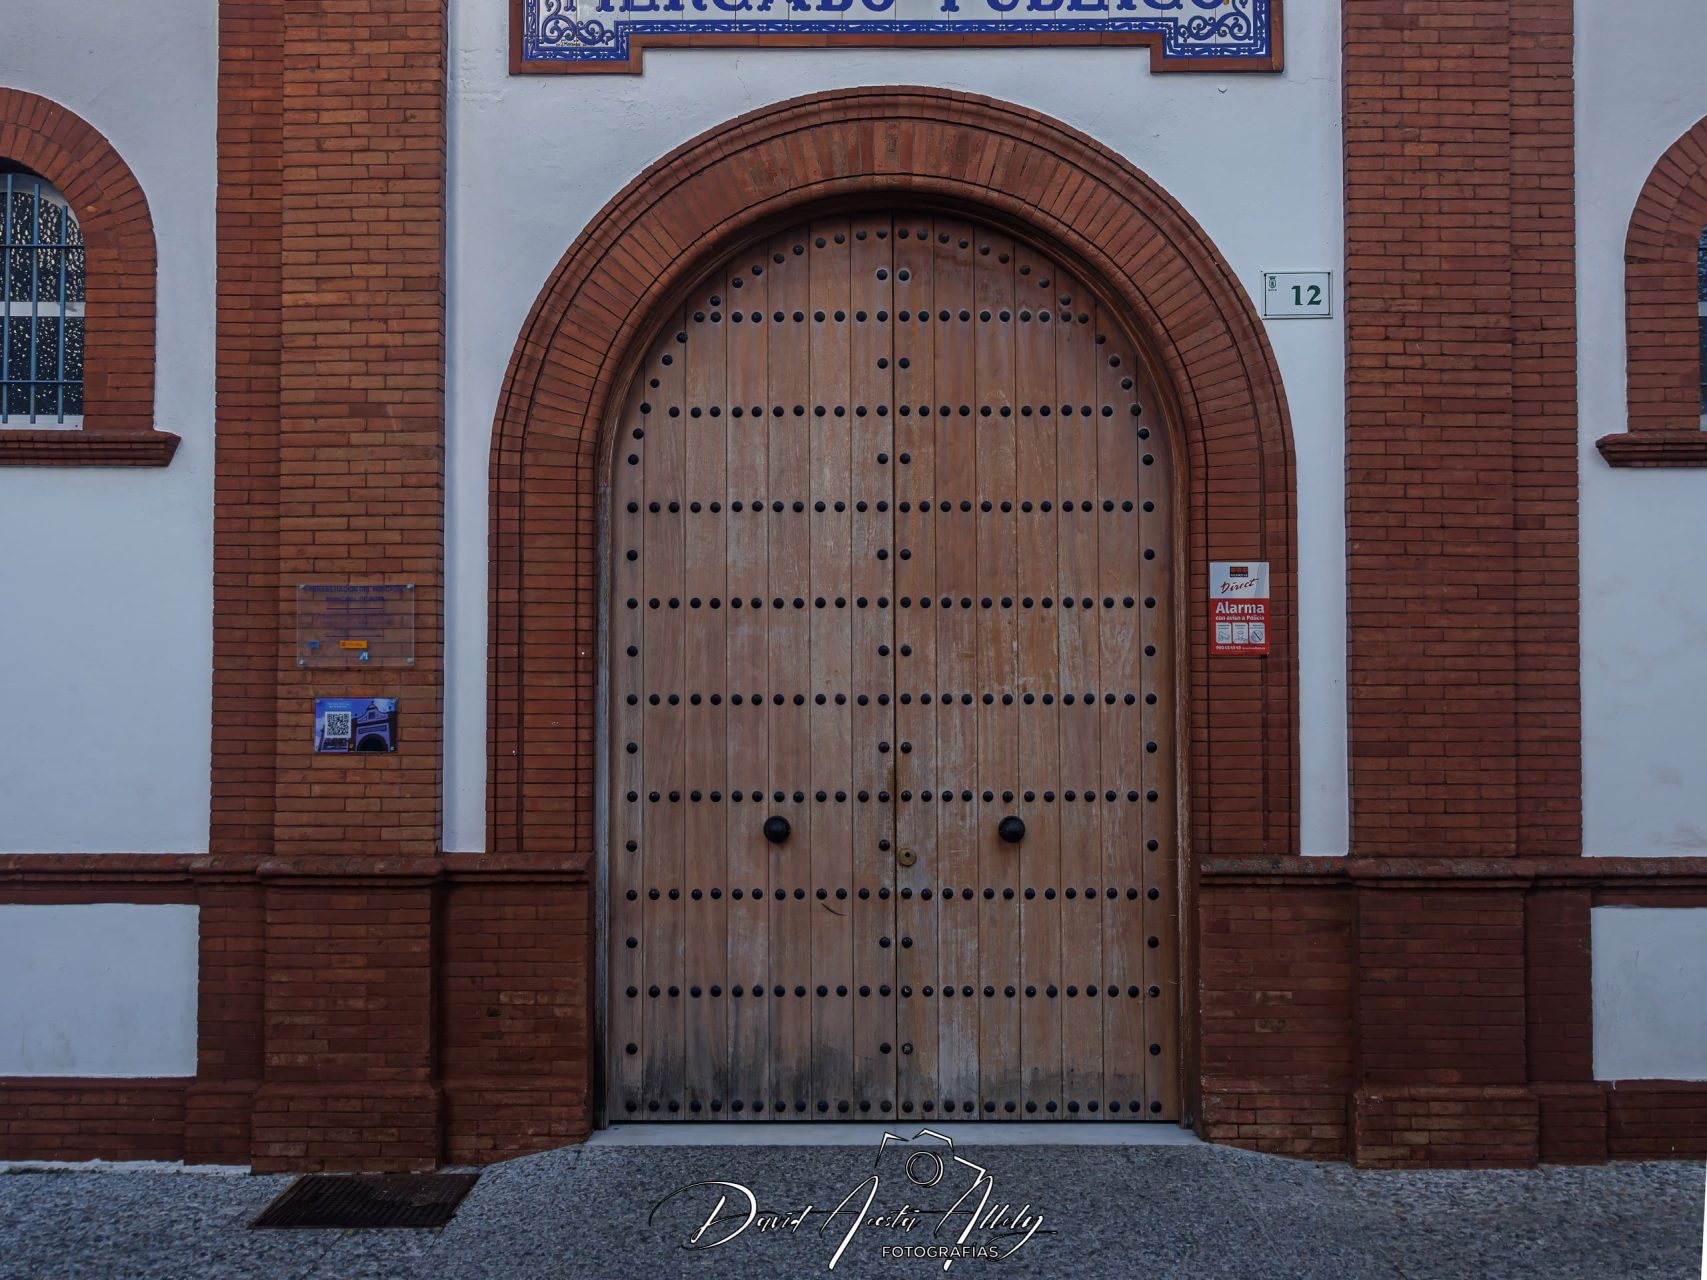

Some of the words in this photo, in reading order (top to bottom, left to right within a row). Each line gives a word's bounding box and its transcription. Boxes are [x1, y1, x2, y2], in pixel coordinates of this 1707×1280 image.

[1291, 285, 1322, 305] 12
[1220, 578, 1259, 594] Direct
[1215, 601, 1265, 614] Alarma
